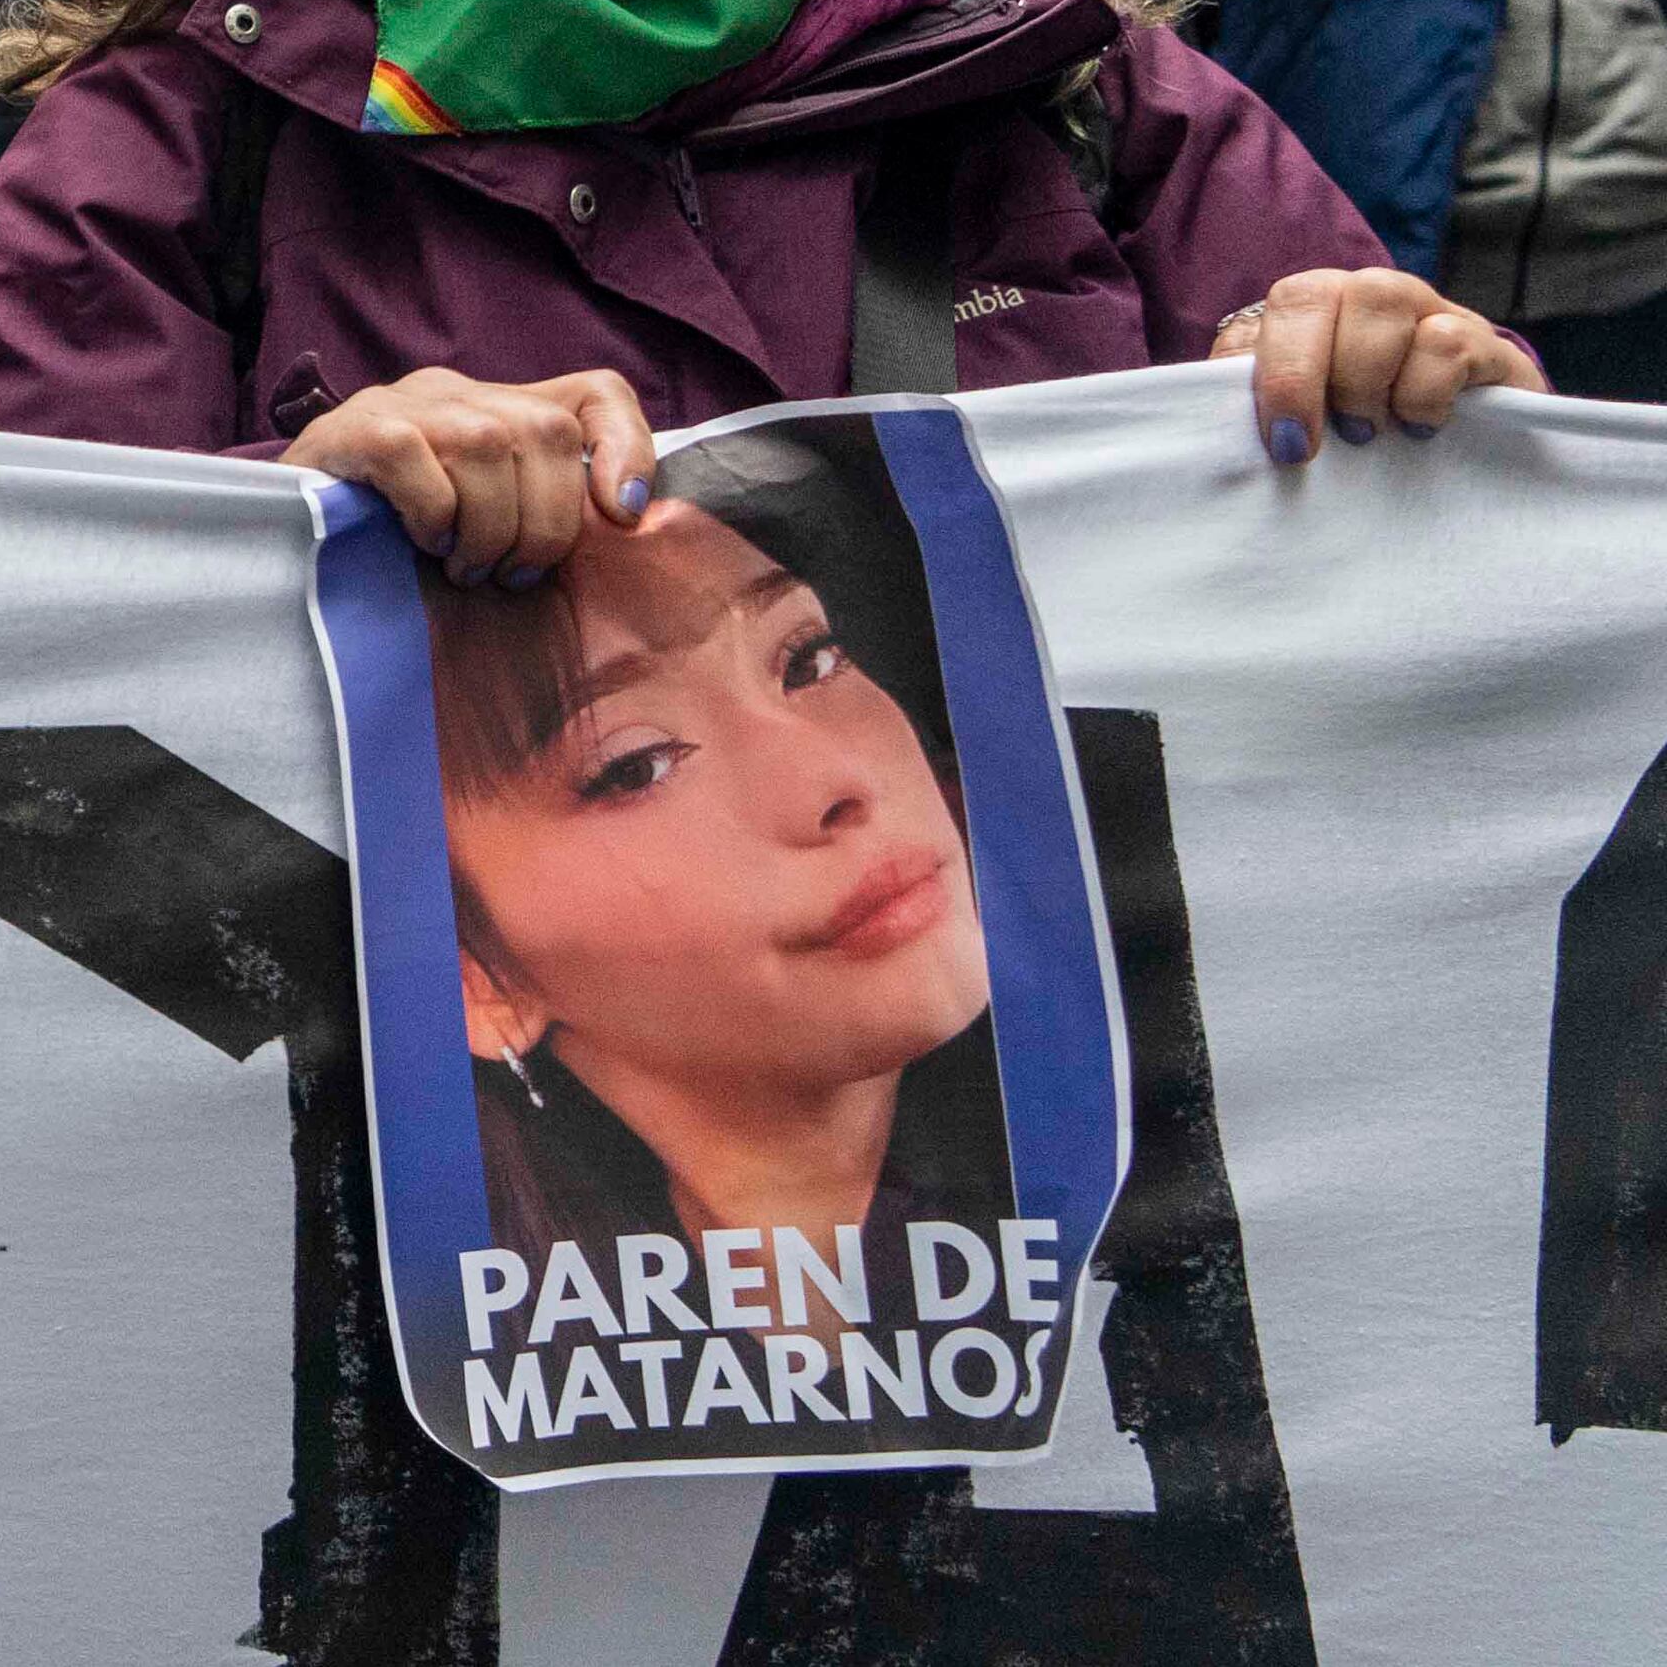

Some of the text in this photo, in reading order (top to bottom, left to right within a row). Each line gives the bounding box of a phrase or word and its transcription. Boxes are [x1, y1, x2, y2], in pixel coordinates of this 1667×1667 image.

[458, 1218, 1061, 1352] PAREN DE
[462, 1327, 1052, 1450] MATARNOS
